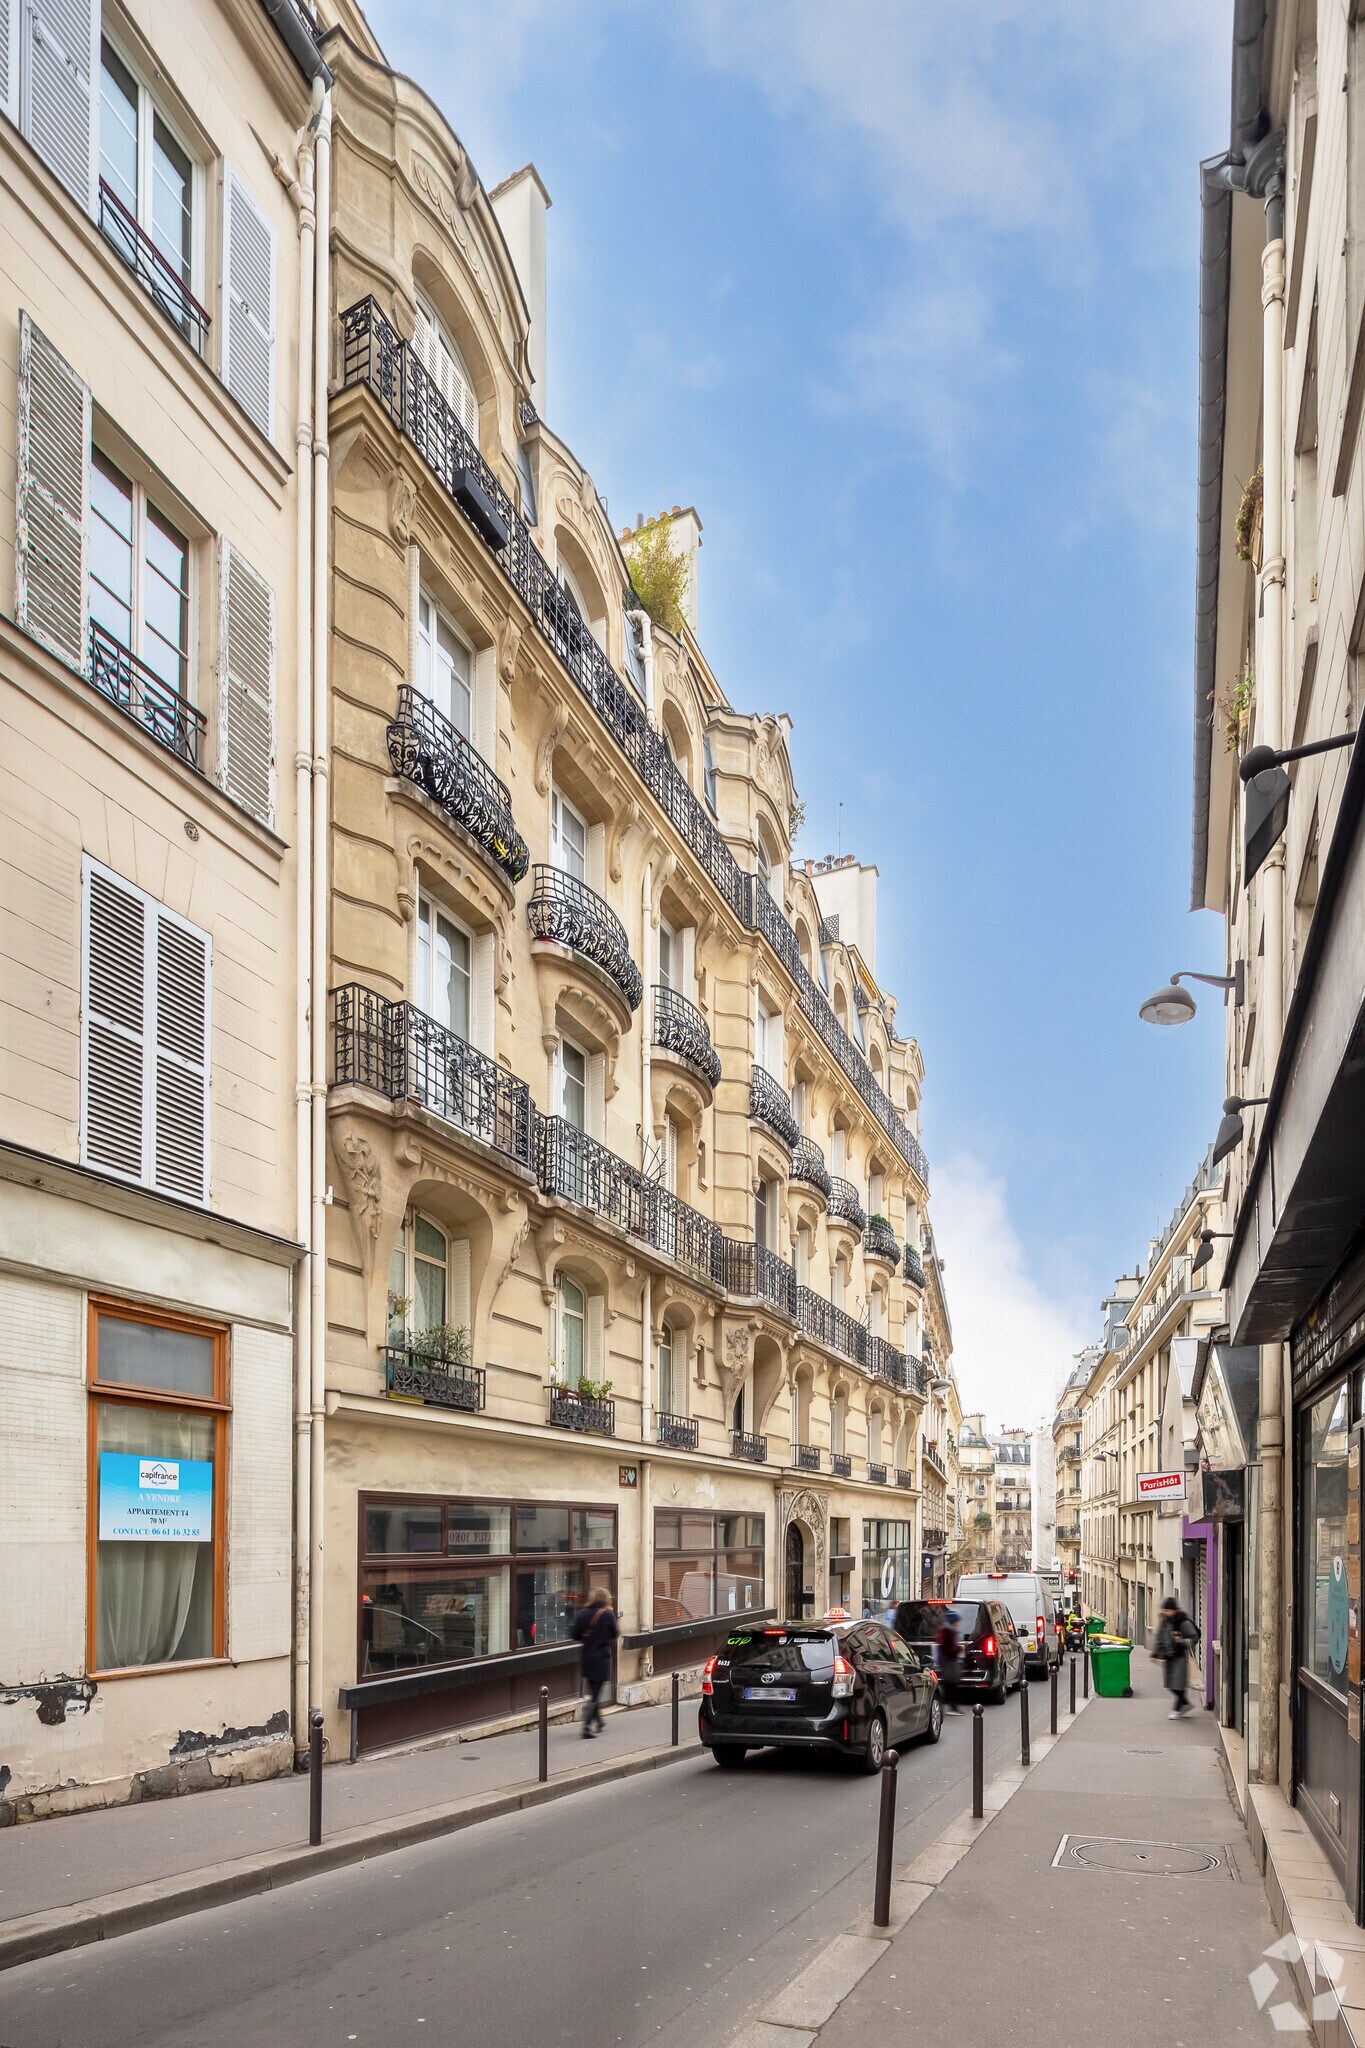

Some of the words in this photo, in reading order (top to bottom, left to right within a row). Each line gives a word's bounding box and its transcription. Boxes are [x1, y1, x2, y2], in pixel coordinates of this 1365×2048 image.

[140, 1470, 178, 1481] capifrance
[138, 1493, 144, 1501] A
[146, 1493, 181, 1503] VENDRE
[127, 1507, 179, 1516] APPARTEMENT
[112, 1527, 151, 1535] CONTACT:
[191, 1528, 200, 1536] 85
[727, 1637, 742, 1645] G7
